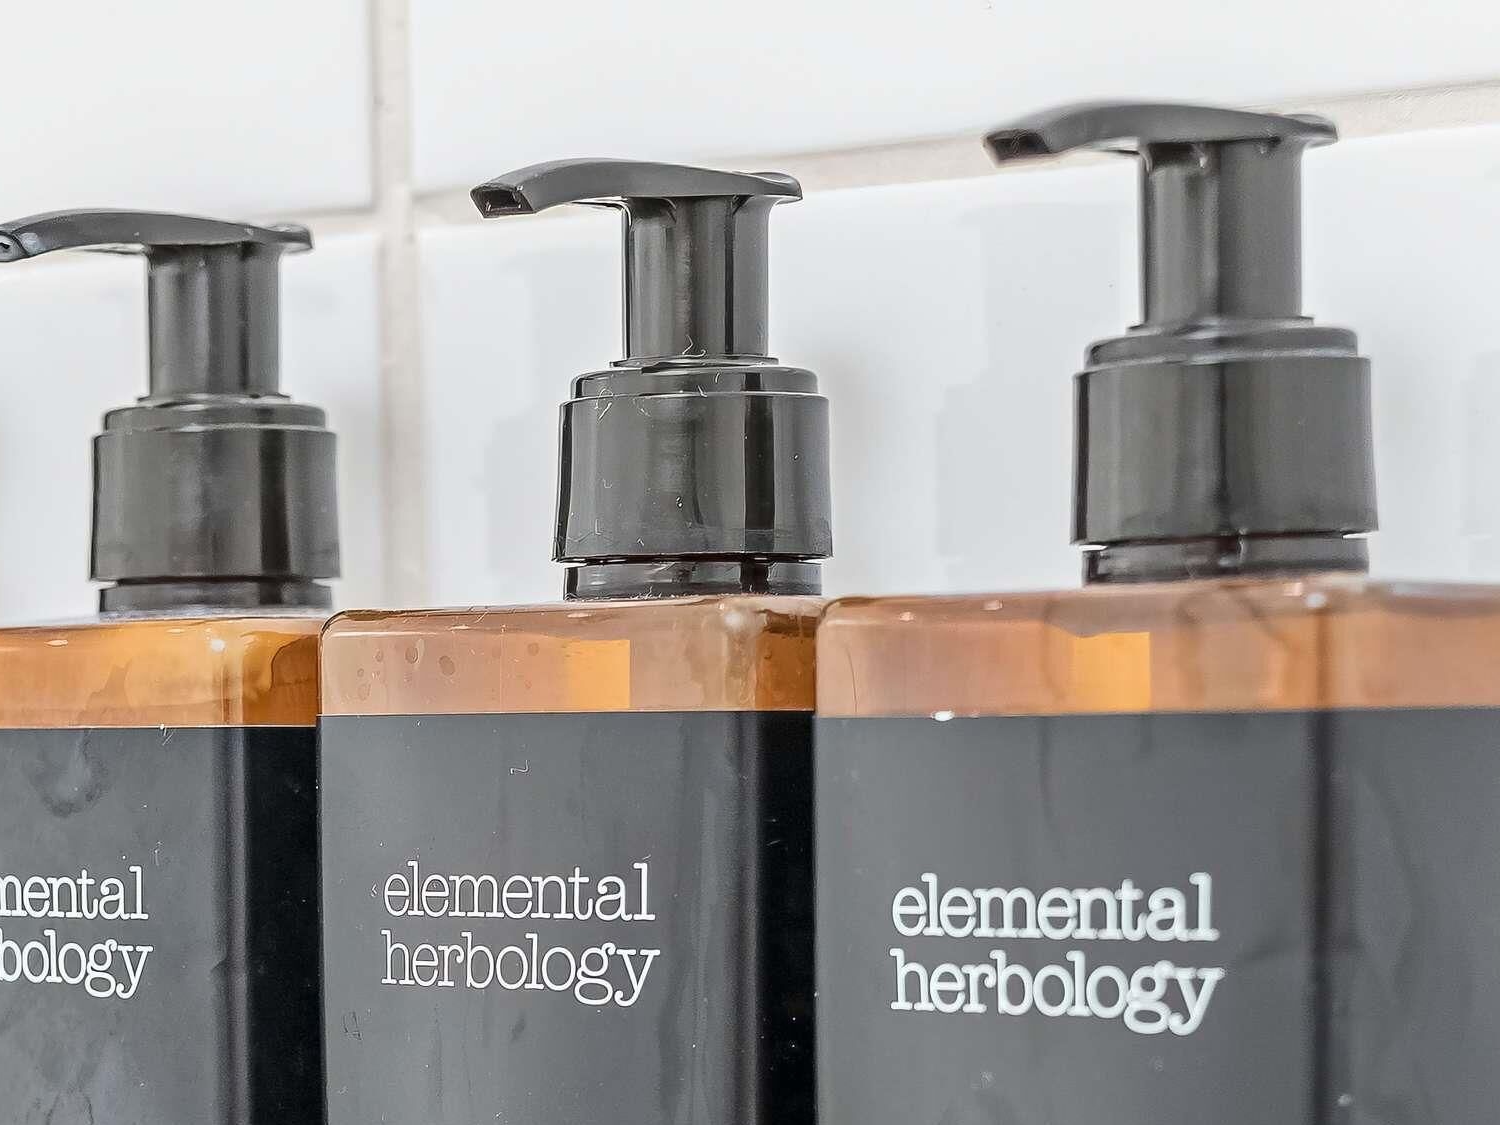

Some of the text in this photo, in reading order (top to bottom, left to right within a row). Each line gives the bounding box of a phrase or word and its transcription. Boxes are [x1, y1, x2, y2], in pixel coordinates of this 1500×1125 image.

[384, 860, 656, 921] elemental
[891, 872, 1220, 942] elemental
[380, 929, 661, 1007] herbology
[889, 948, 1227, 1036] herbology
